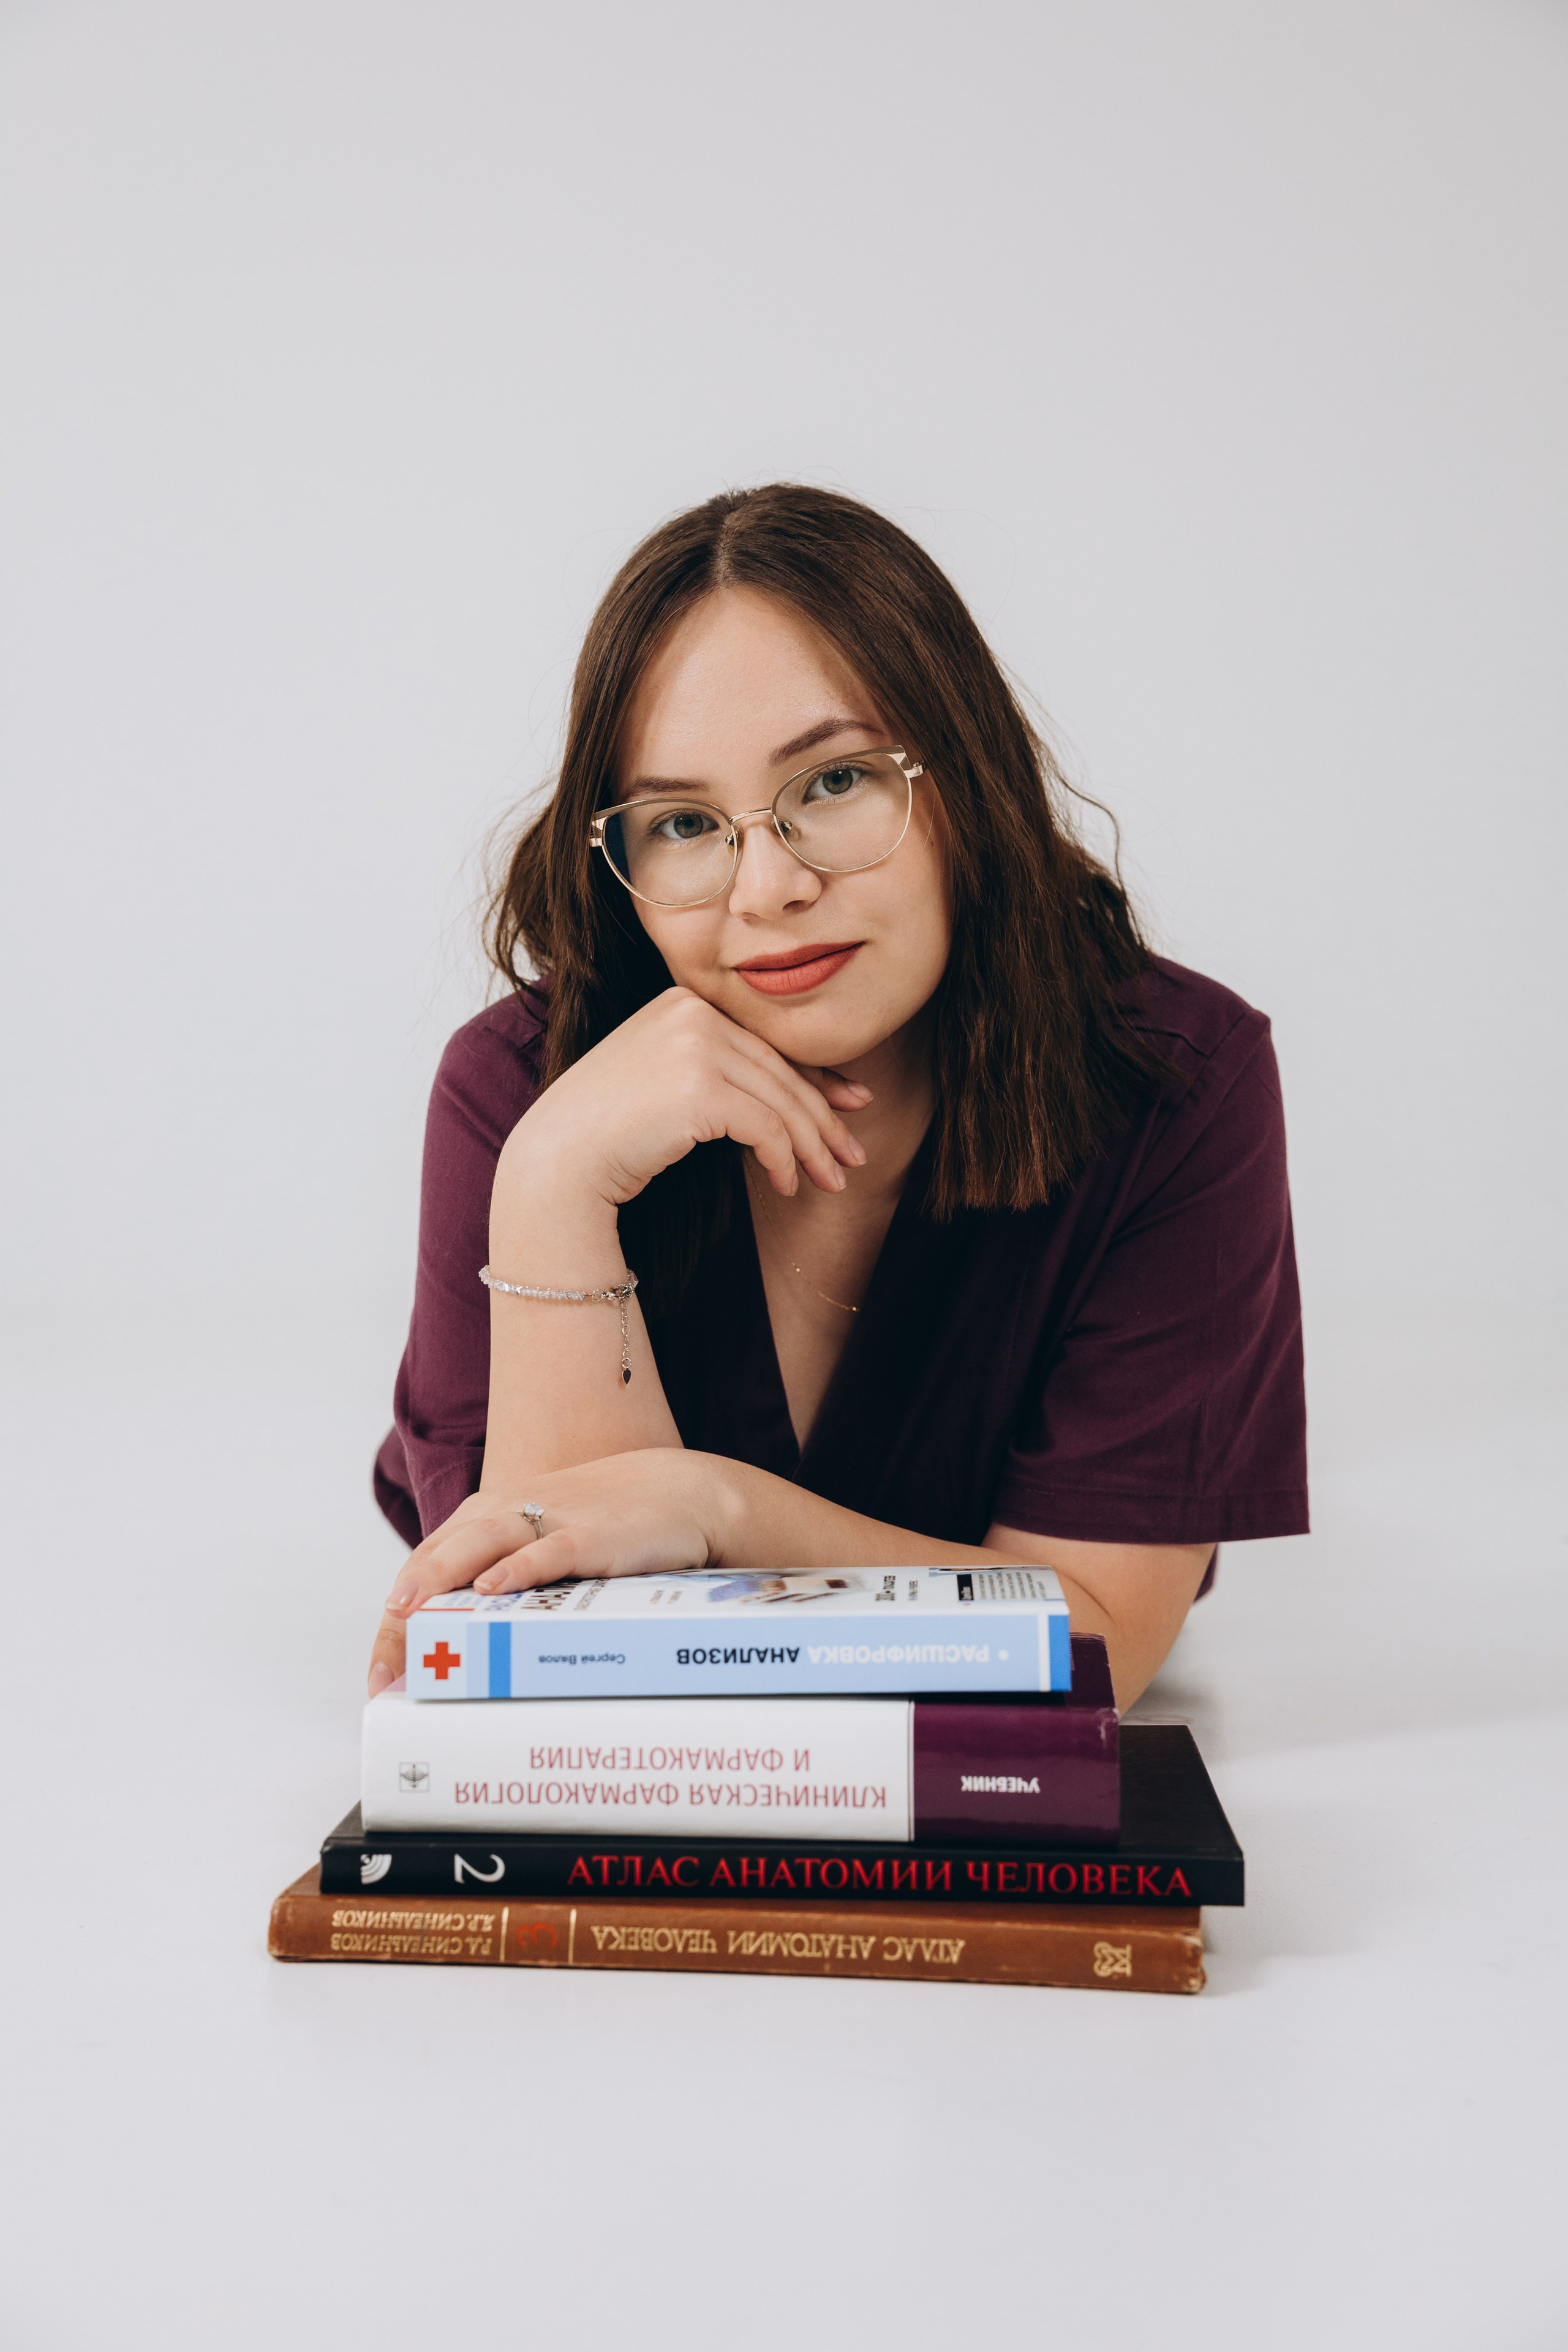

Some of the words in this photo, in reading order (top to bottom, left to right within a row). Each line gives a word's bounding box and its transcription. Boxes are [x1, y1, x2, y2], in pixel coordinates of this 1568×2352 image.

[581, 1653, 626, 1665] Сергей
[676, 1647, 800, 1665] АНАЛИЗОВ
[807, 1645, 990, 1664] РАСШИФРОВКА
[529, 1746, 785, 1772] ФАРМАКОТЕРАПИЯ
[794, 1749, 810, 1772] И
[454, 1781, 679, 1807] ФАРМАКОЛОГИЯ
[689, 1783, 887, 1808] КЛИНИЧЕСКАЯ
[959, 1774, 1041, 1794] УЧЕБНИК
[454, 1853, 505, 1883] 2
[567, 1856, 699, 1886] АТЛАС
[709, 1858, 953, 1890] АНАТОМИИ
[966, 1861, 1192, 1898] ЧЕЛОВЕКА
[331, 1910, 465, 1932] СИНЕЛЬНИКОВ
[330, 1932, 462, 1954] СИНЕЛЬНИКОВ
[516, 1921, 558, 1947] 3
[590, 1925, 717, 1954] ЧЕЛОВЕКА
[728, 1929, 876, 1960] АНАТОМИИ
[883, 1936, 967, 1964] АТЛАС
